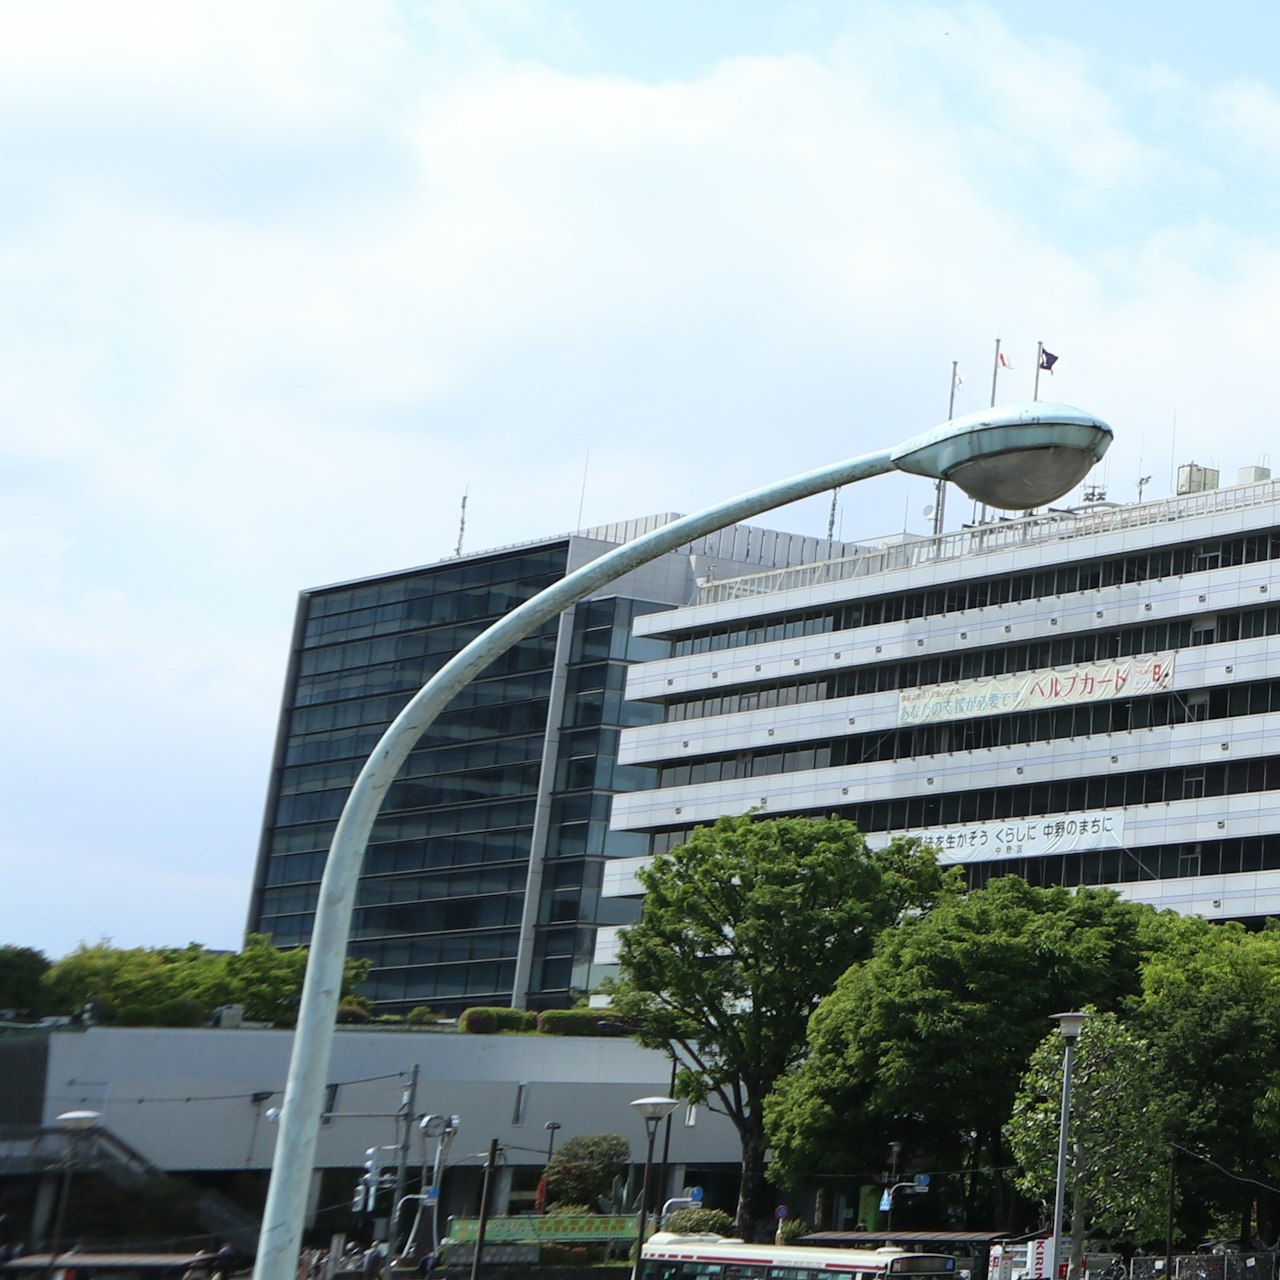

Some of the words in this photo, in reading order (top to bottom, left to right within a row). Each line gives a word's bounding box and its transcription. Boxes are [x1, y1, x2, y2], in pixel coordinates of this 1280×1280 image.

[1029, 667, 1129, 699] ヘルプカード
[900, 689, 1021, 721] あなたの支援が必要です
[995, 824, 1037, 844] くらしに
[1042, 816, 1114, 840] 中野のまちに
[1034, 1240, 1046, 1280] KIRIN
